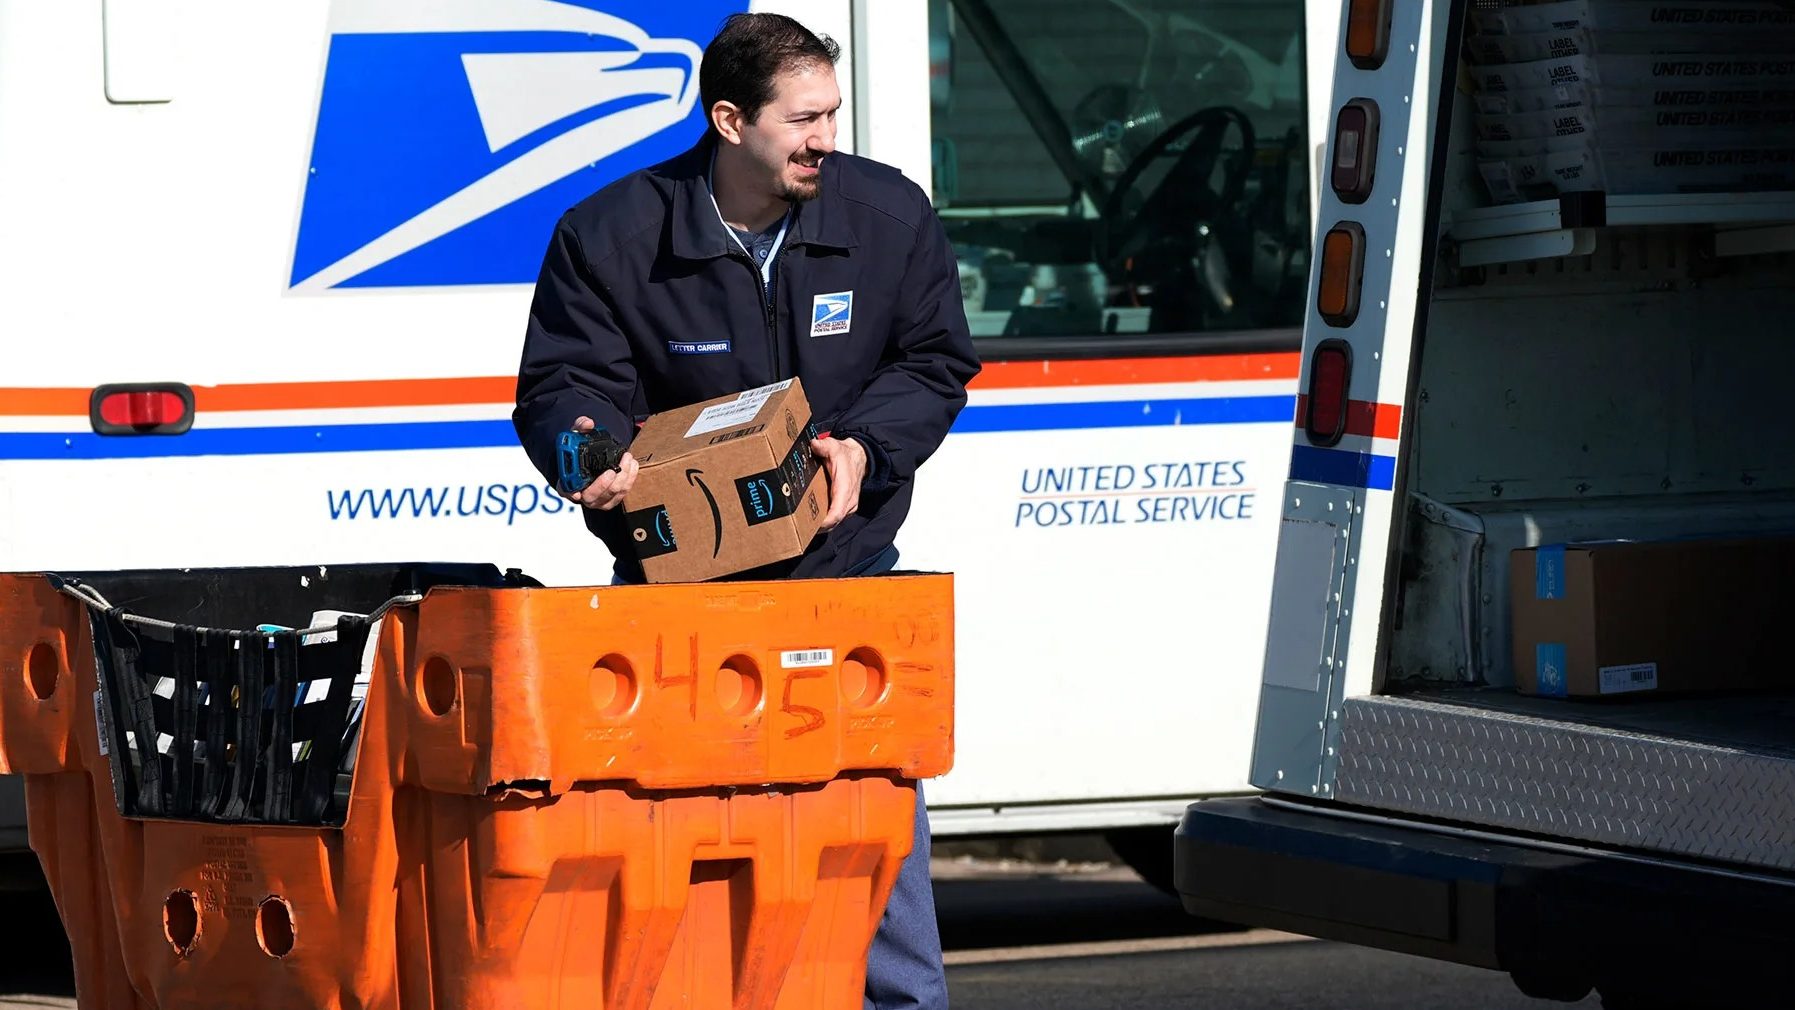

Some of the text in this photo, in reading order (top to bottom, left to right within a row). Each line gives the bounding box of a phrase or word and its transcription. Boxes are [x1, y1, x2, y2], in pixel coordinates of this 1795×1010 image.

[1651, 8, 1703, 23] UNITED
[1704, 8, 1757, 24] STATES
[1548, 38, 1576, 50] LABEL
[1548, 65, 1577, 78] LABEL
[1652, 61, 1703, 77] UNITED
[1705, 61, 1757, 76] STATES
[1654, 90, 1705, 105] UNITED
[1554, 116, 1582, 129] LABEL
[1656, 111, 1706, 126] UNITED
[1654, 151, 1704, 167] UNITED
[1706, 150, 1758, 165] STATES
[671, 343, 728, 352] LETTER CARRIER
[1021, 460, 1247, 494] UNITED STATES
[746, 480, 769, 519] prime
[1015, 494, 1256, 528] POSTAL SERVICE
[653, 632, 699, 722] 4
[782, 670, 829, 741] 5
